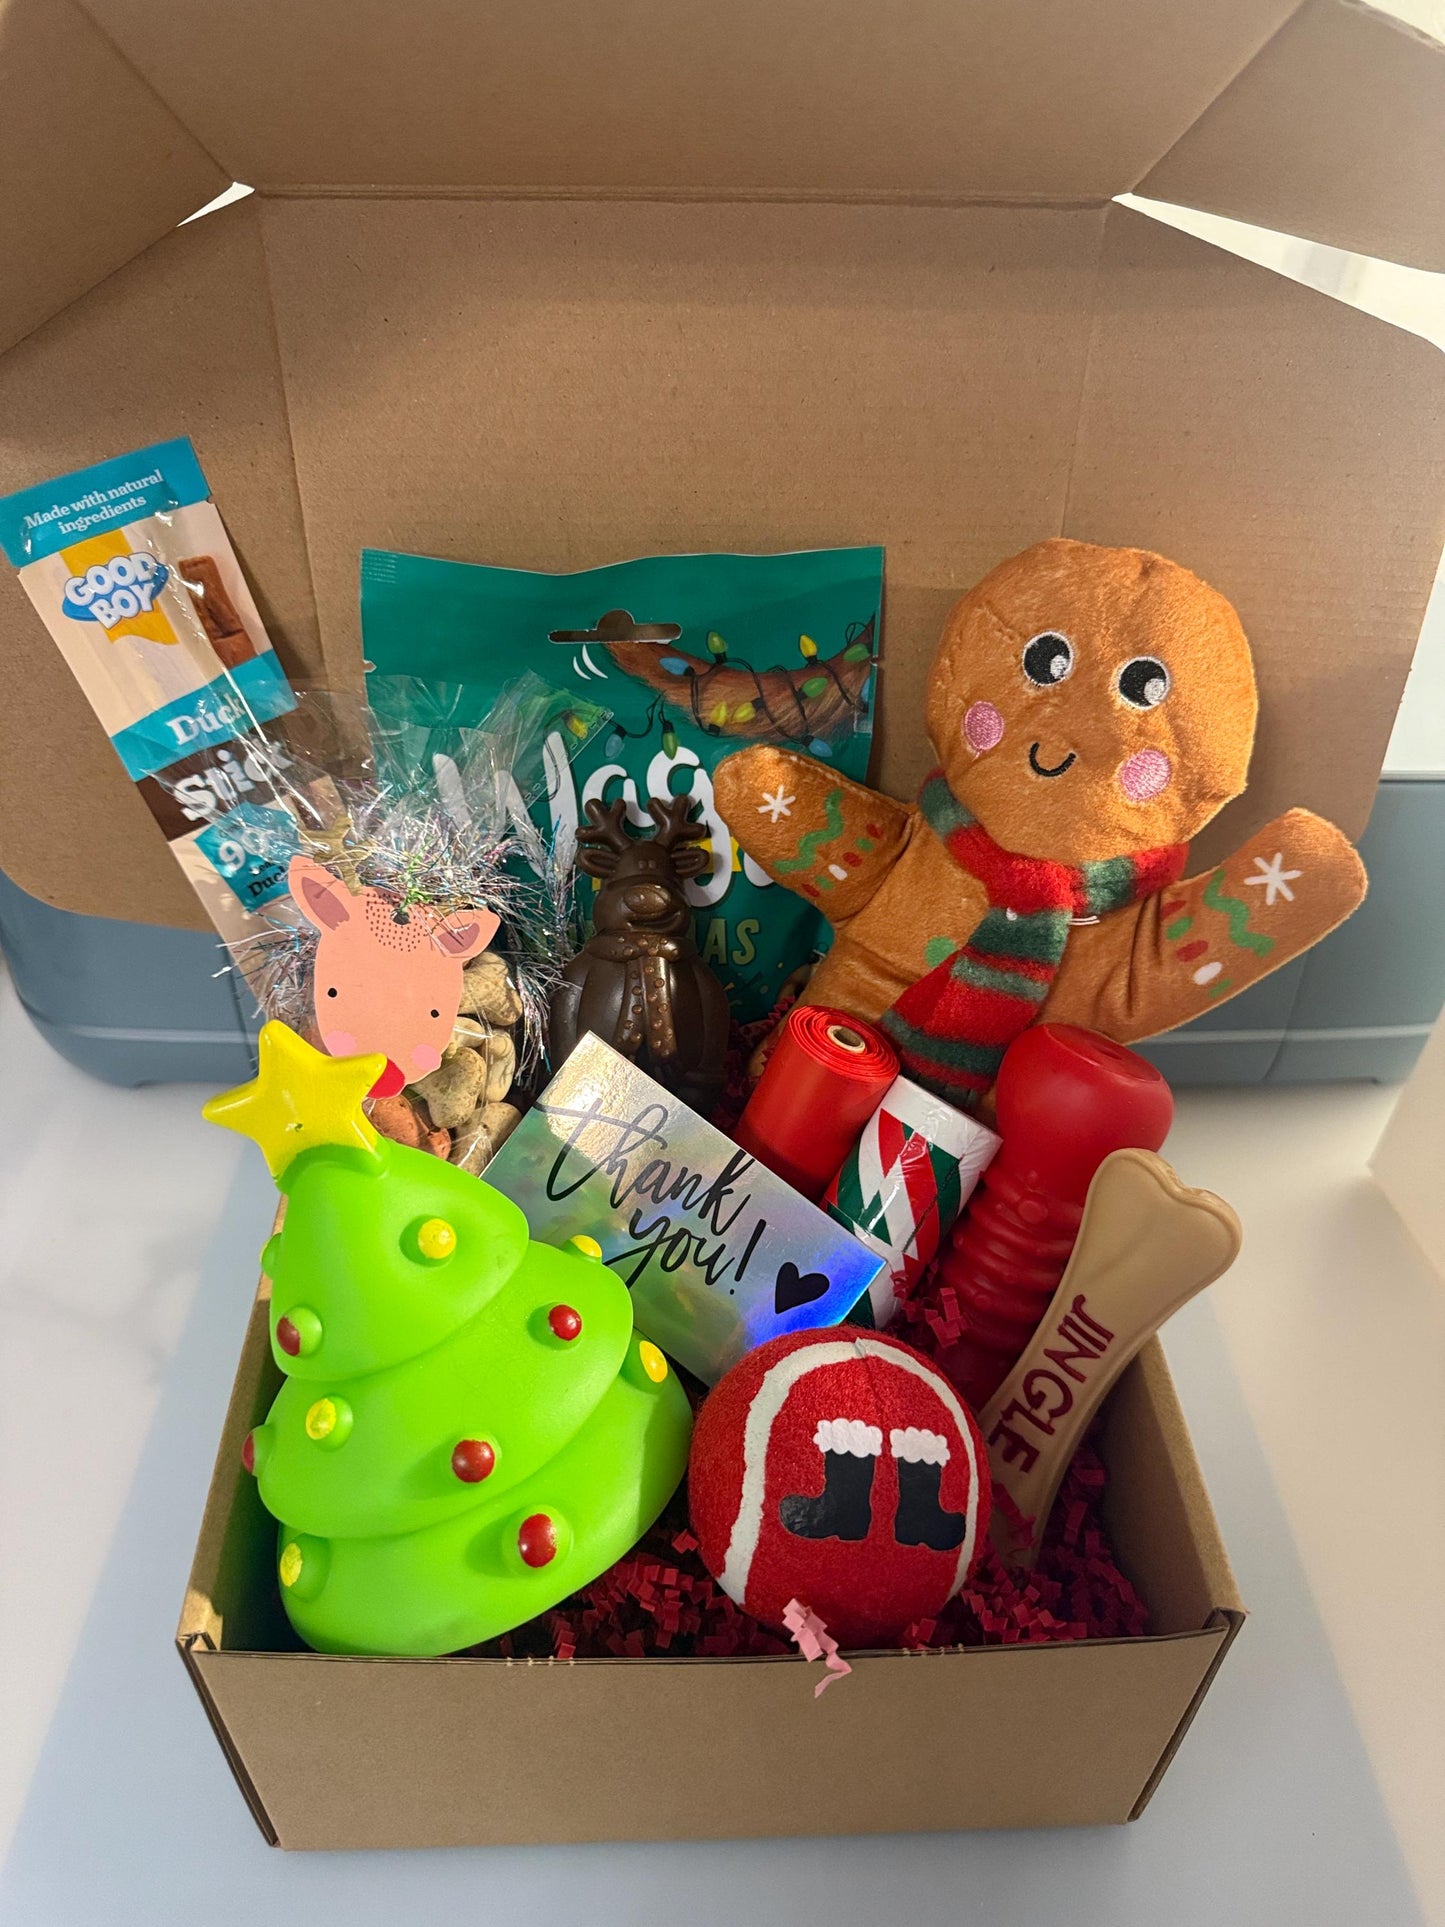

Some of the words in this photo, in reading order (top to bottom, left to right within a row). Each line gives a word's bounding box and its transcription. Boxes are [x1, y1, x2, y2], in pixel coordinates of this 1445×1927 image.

[23, 504, 71, 530] Made
[70, 490, 109, 513] with
[107, 468, 164, 500] natural
[57, 495, 147, 535] ingredients
[64, 551, 158, 607] GOOD
[88, 582, 156, 630] BOY
[165, 692, 247, 746] Duck
[604, 1207, 767, 1296] you!
[987, 1293, 1115, 1474] JINGLE
